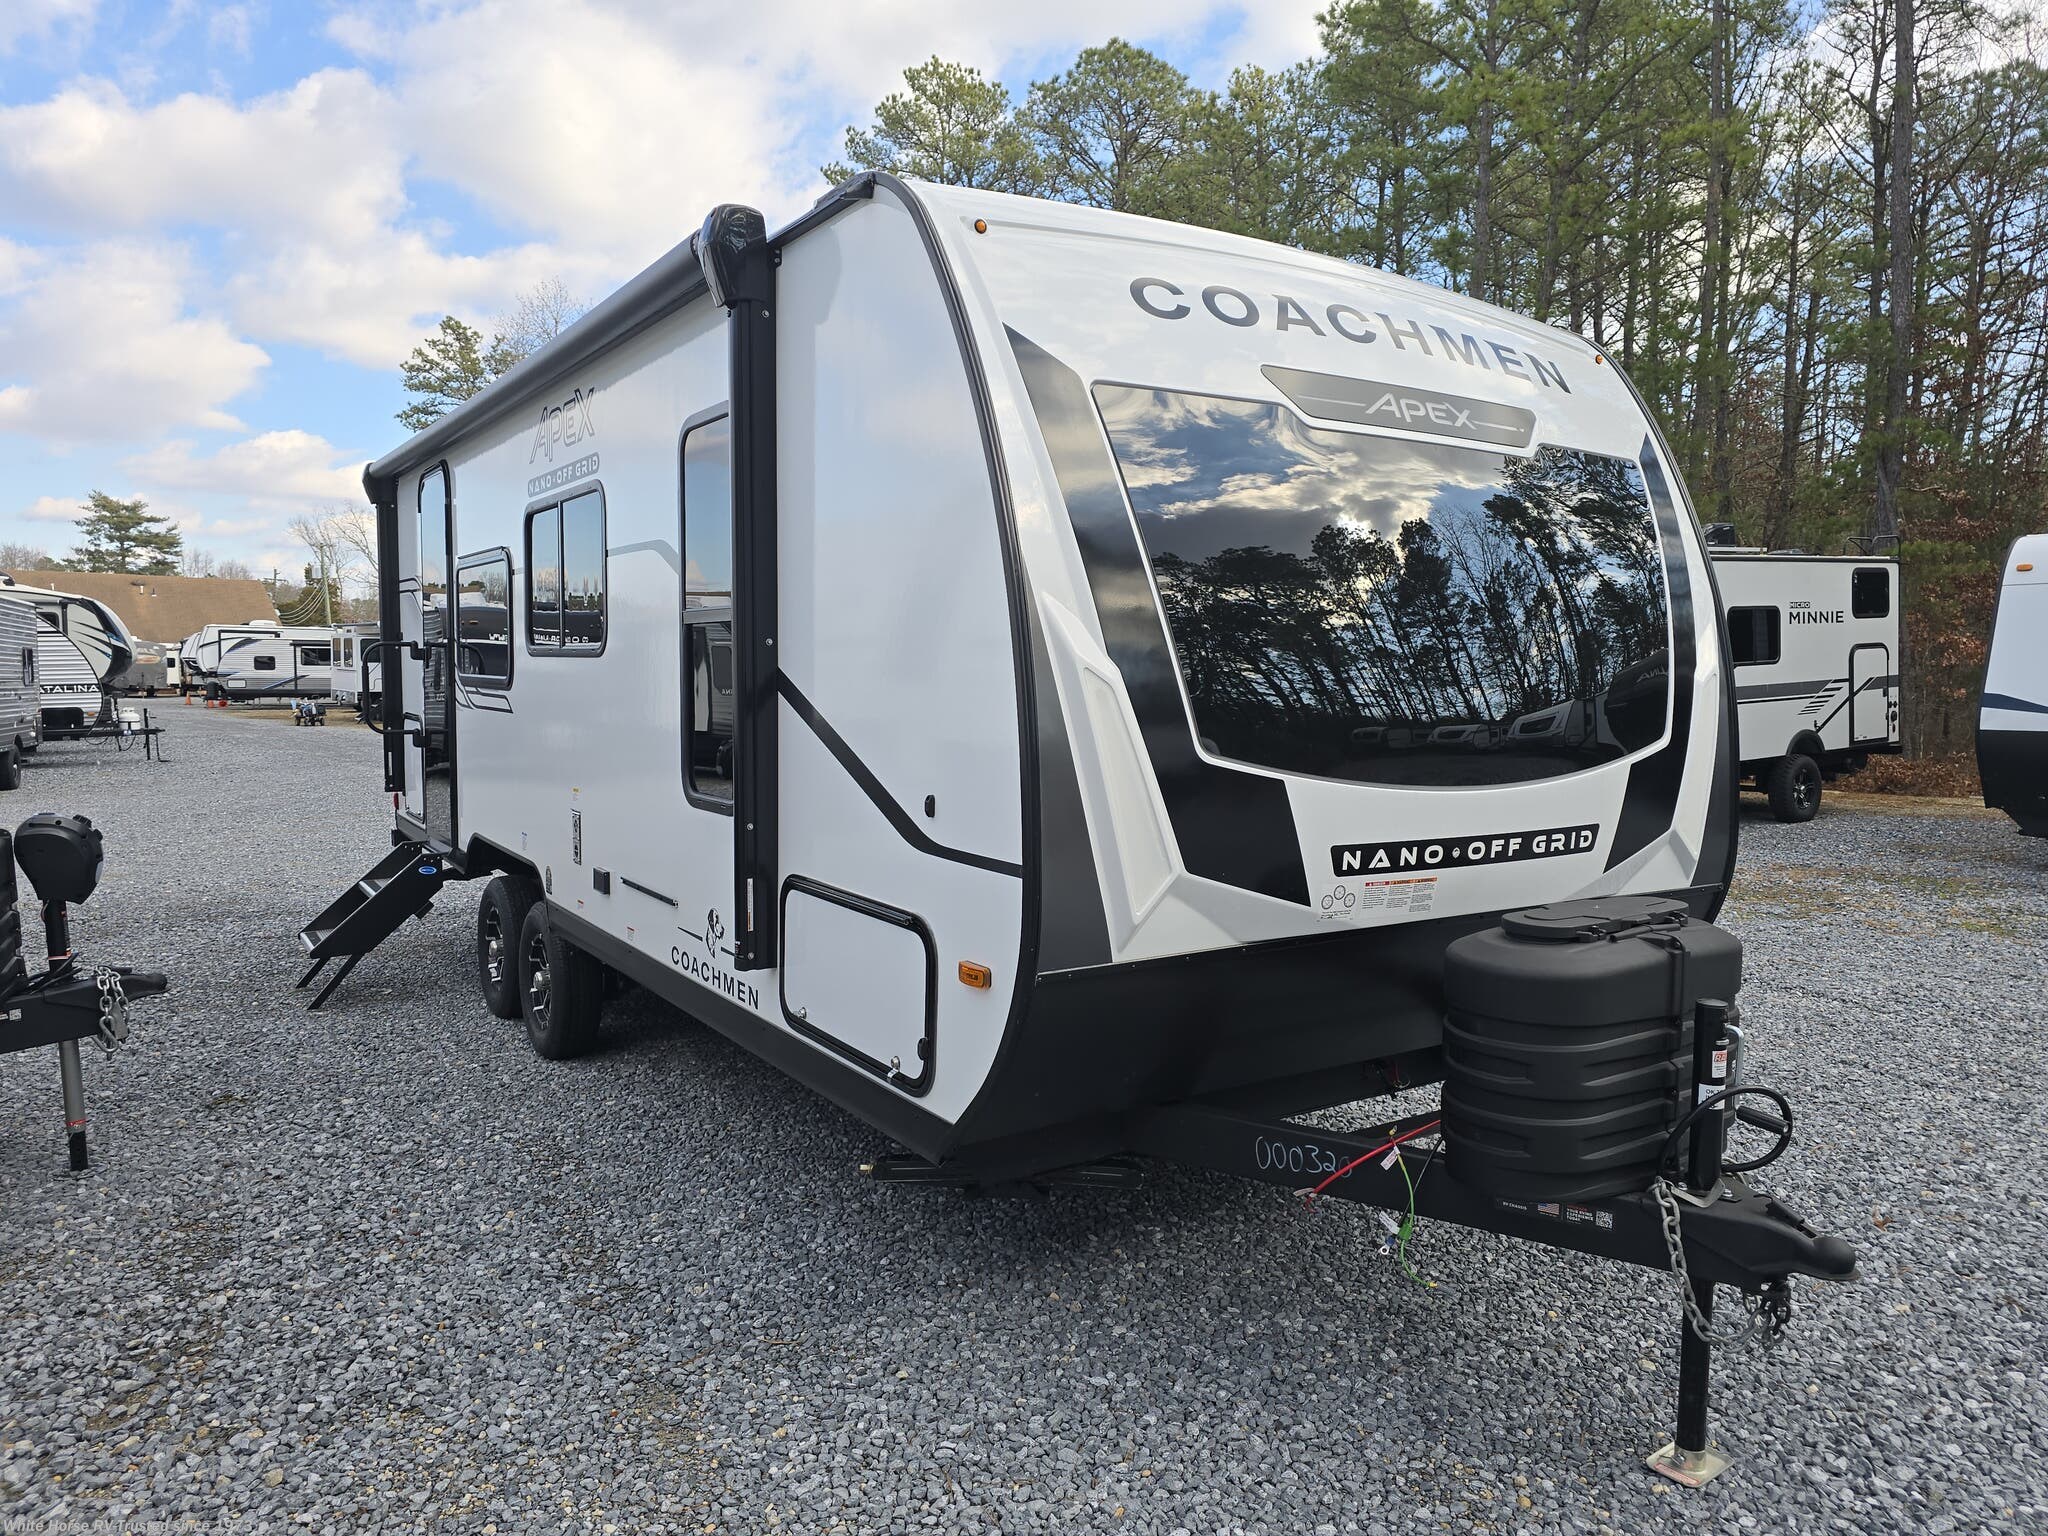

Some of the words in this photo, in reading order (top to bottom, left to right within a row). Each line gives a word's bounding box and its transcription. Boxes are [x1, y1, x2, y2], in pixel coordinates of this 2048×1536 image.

[1130, 277, 1571, 394] COACHMEN
[528, 387, 596, 464] APEX
[1365, 392, 1476, 430] APEX
[528, 475, 553, 495] NANO
[556, 466, 573, 485] OFF
[575, 456, 599, 476] GRID
[1789, 611, 1844, 625] MINNIE
[1342, 845, 1444, 871] NANO
[1467, 837, 1523, 861] OFF
[1532, 830, 1593, 854] GRID
[671, 945, 760, 1010] COACHMEN
